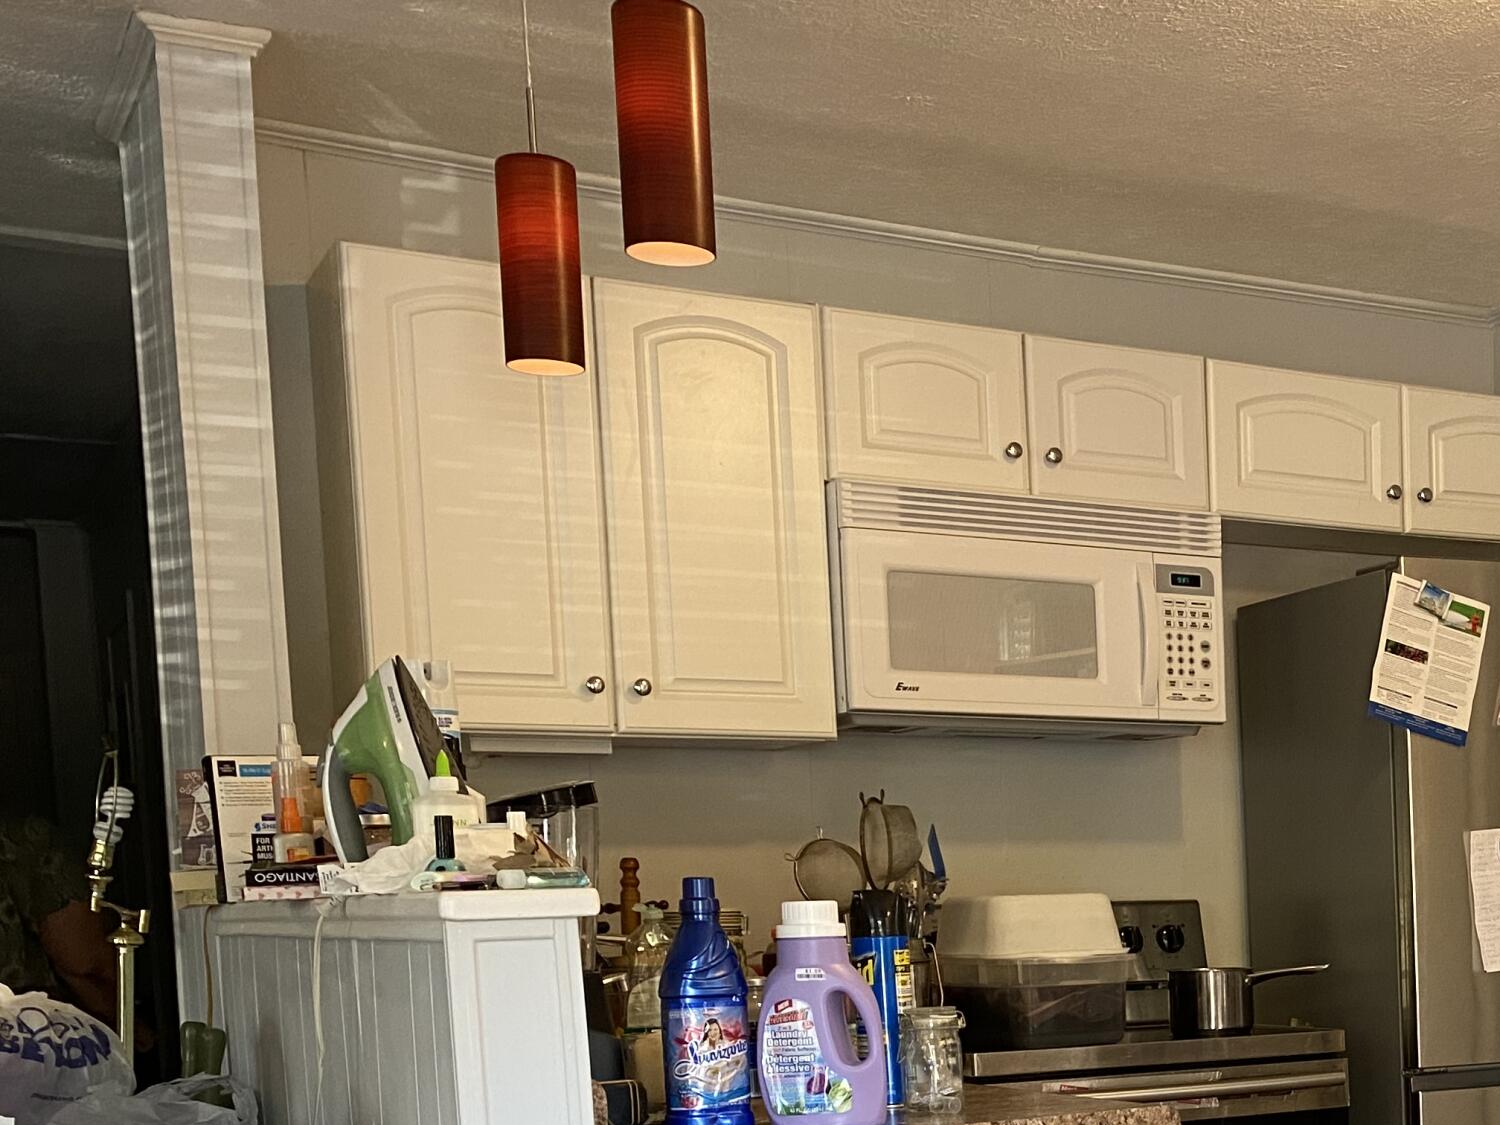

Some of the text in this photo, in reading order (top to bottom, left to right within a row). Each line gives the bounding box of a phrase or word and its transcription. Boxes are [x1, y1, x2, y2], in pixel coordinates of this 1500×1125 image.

[254, 871, 319, 883] ANTIAGO
[771, 1030, 808, 1040] Laundry
[767, 1038, 814, 1048] Detergent
